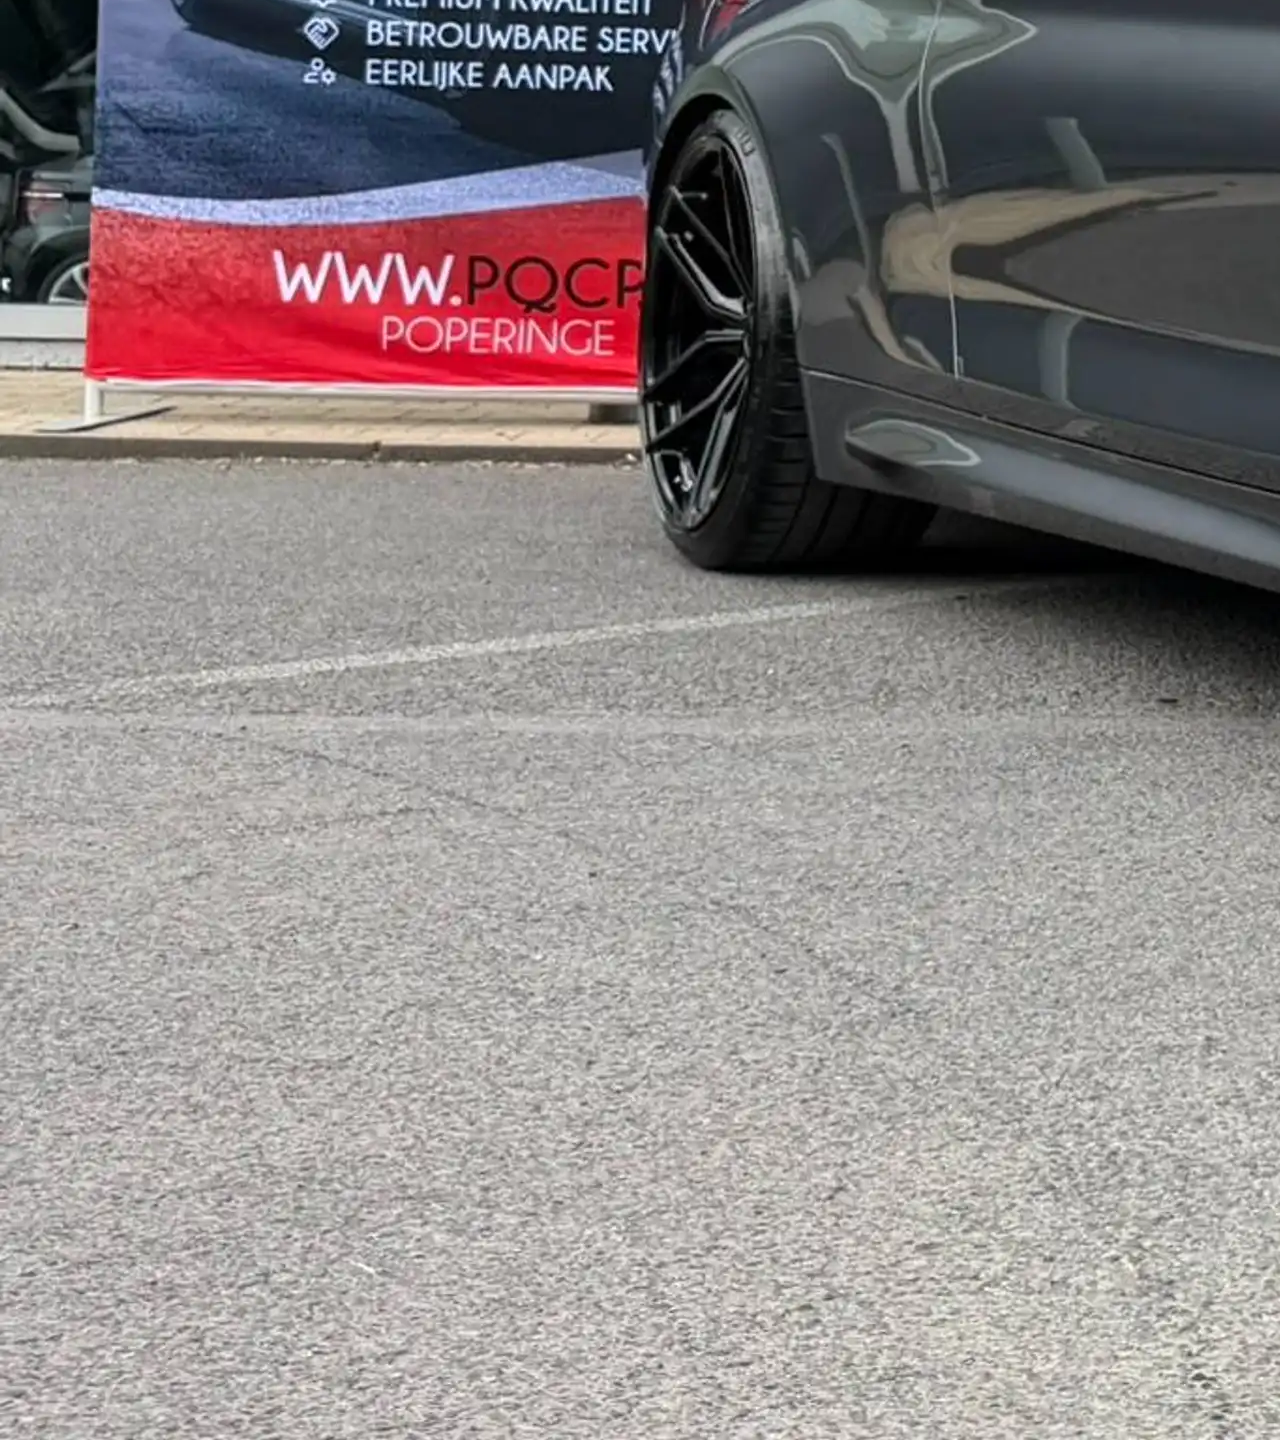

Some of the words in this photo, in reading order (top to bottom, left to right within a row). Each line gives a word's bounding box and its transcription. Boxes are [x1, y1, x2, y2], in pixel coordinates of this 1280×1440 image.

[366, 20, 587, 53] BETROUWBARE
[597, 26, 676, 54] SERV
[365, 59, 484, 92] EERLIJKE
[492, 63, 614, 92] AANPAK
[381, 315, 616, 357] POPERINGE
